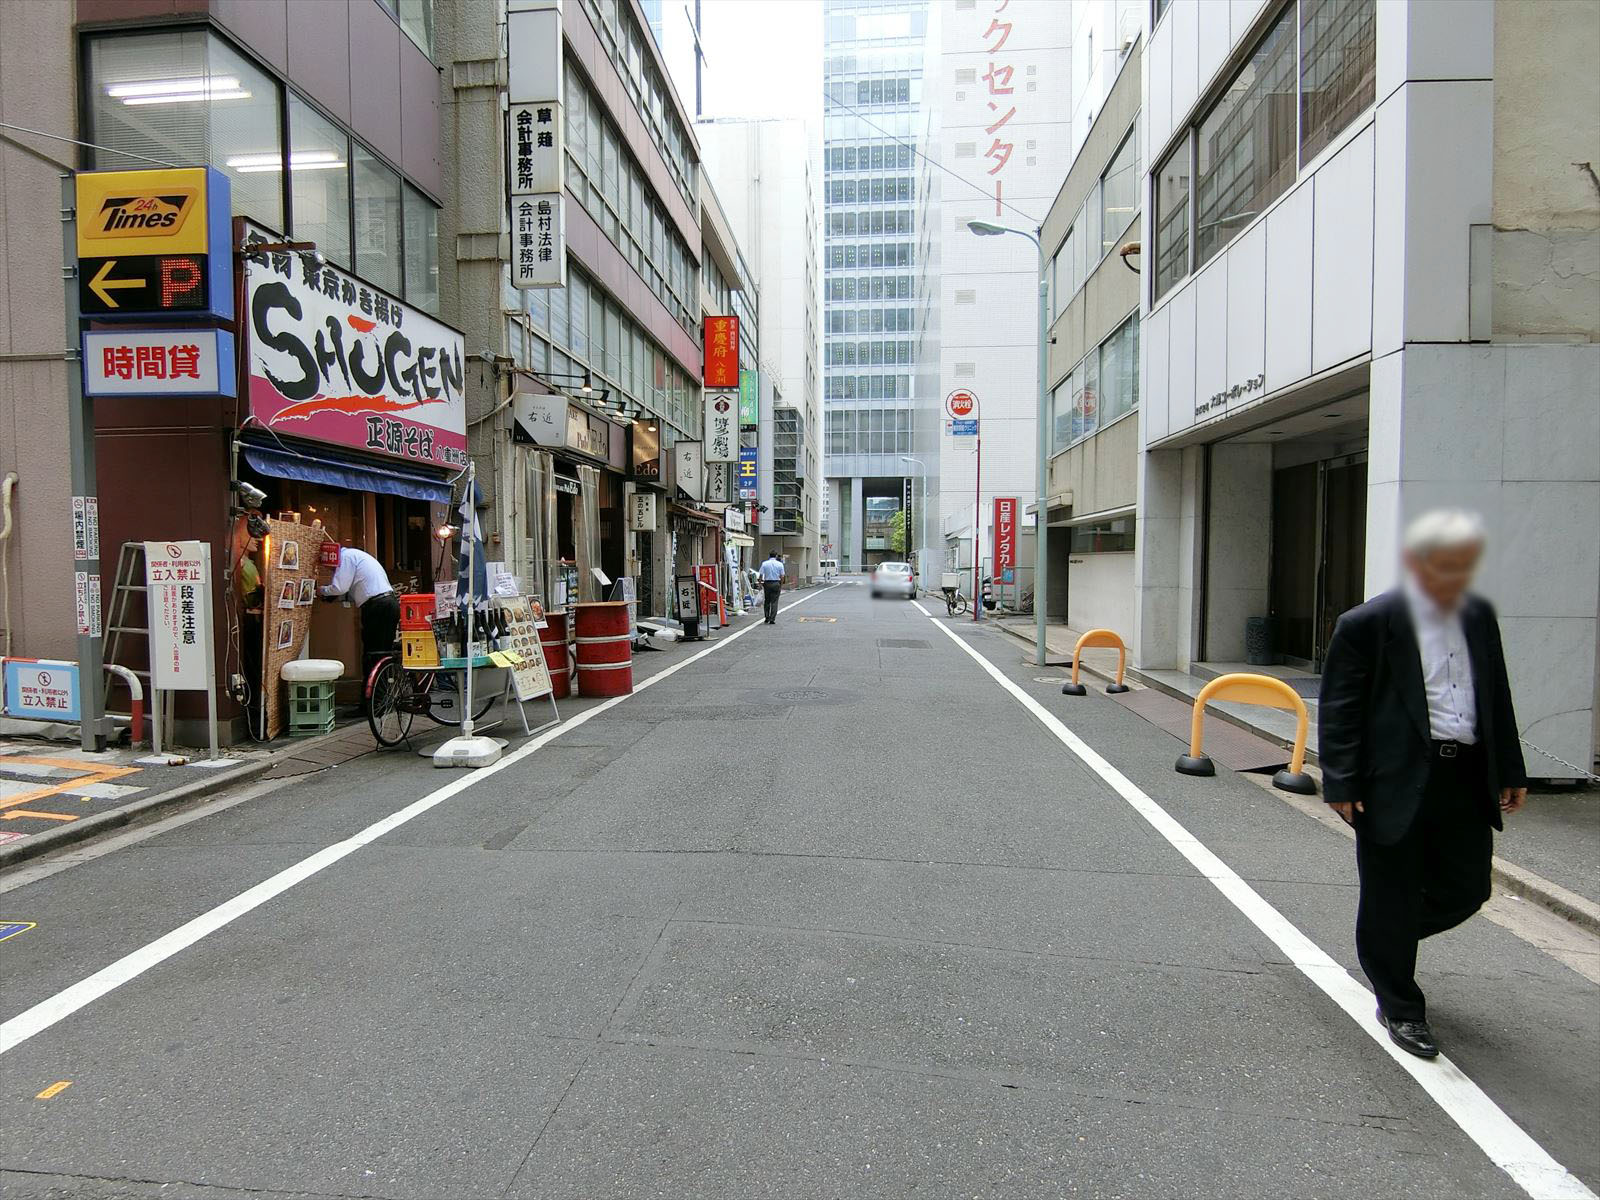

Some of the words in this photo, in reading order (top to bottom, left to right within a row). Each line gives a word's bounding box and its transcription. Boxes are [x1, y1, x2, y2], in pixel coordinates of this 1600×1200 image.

[516, 109, 534, 189] 会計事務所
[103, 206, 178, 232] Times
[537, 199, 553, 262] 島村法律
[518, 200, 534, 279] 会計事務所
[160, 257, 202, 308] P
[712, 319, 728, 358] 重慶府
[102, 344, 201, 380] 時間貸
[527, 411, 553, 425] 右近
[954, 399, 972, 409] 消火栓
[365, 415, 434, 460] 正源そば
[633, 463, 659, 476] Edo
[683, 451, 694, 479] 右近
[740, 461, 757, 477] 王
[1000, 502, 1011, 571] 日産レンタカー
[152, 568, 201, 581] 立入禁止
[180, 585, 196, 645] 段差注意
[23, 694, 68, 709] 立入禁止
